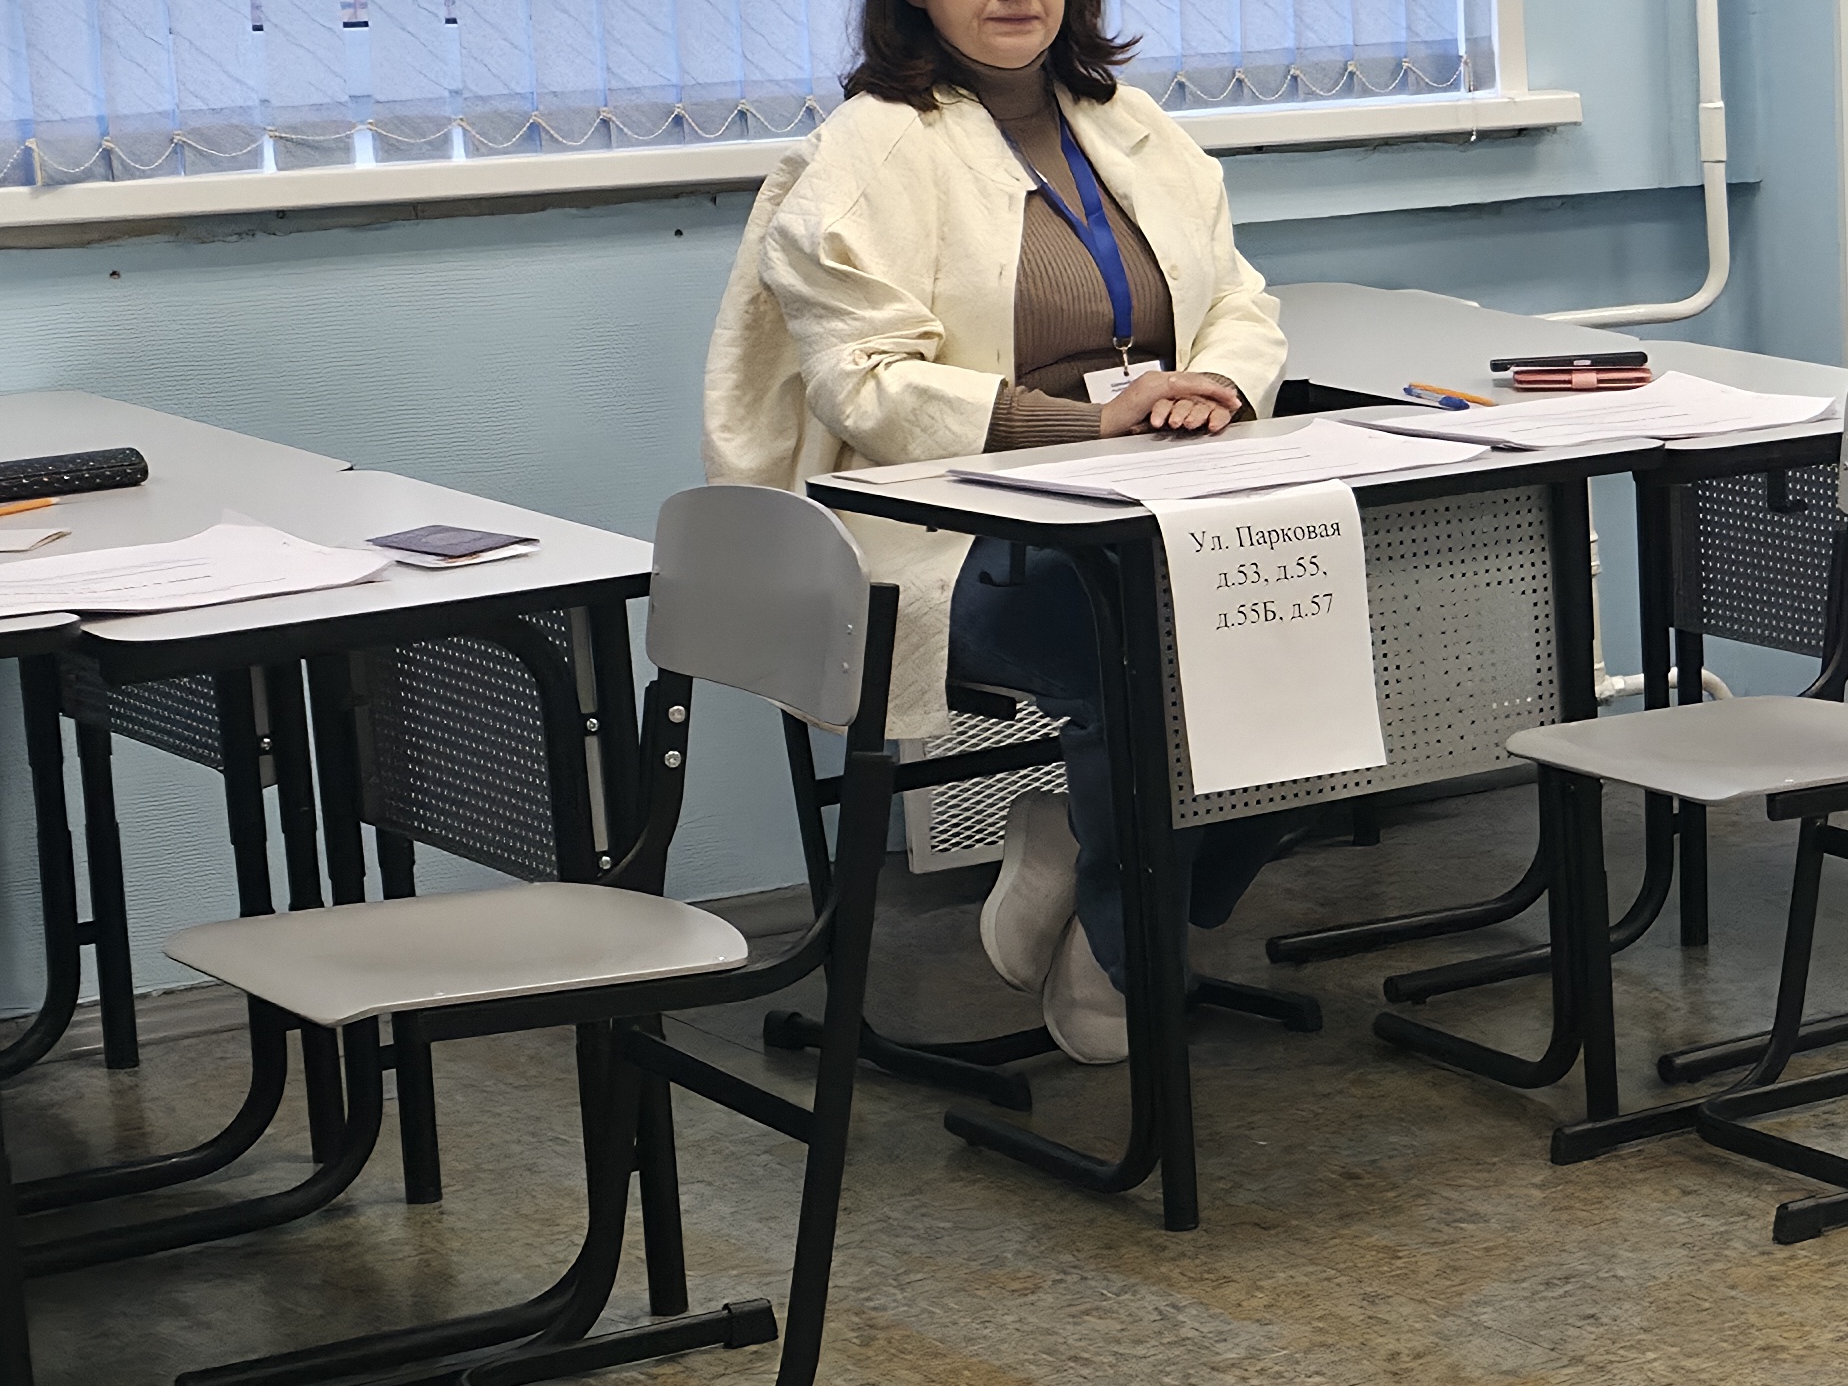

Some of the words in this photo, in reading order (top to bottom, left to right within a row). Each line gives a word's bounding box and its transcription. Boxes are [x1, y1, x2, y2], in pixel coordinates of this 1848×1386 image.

[1188, 530, 1230, 553] Ул.
[1235, 519, 1342, 551] Парковая
[1216, 561, 1270, 590] д.53,
[1275, 554, 1328, 582] д.55,
[1215, 600, 1284, 630] д.55Б,
[1290, 592, 1334, 621] д.57
